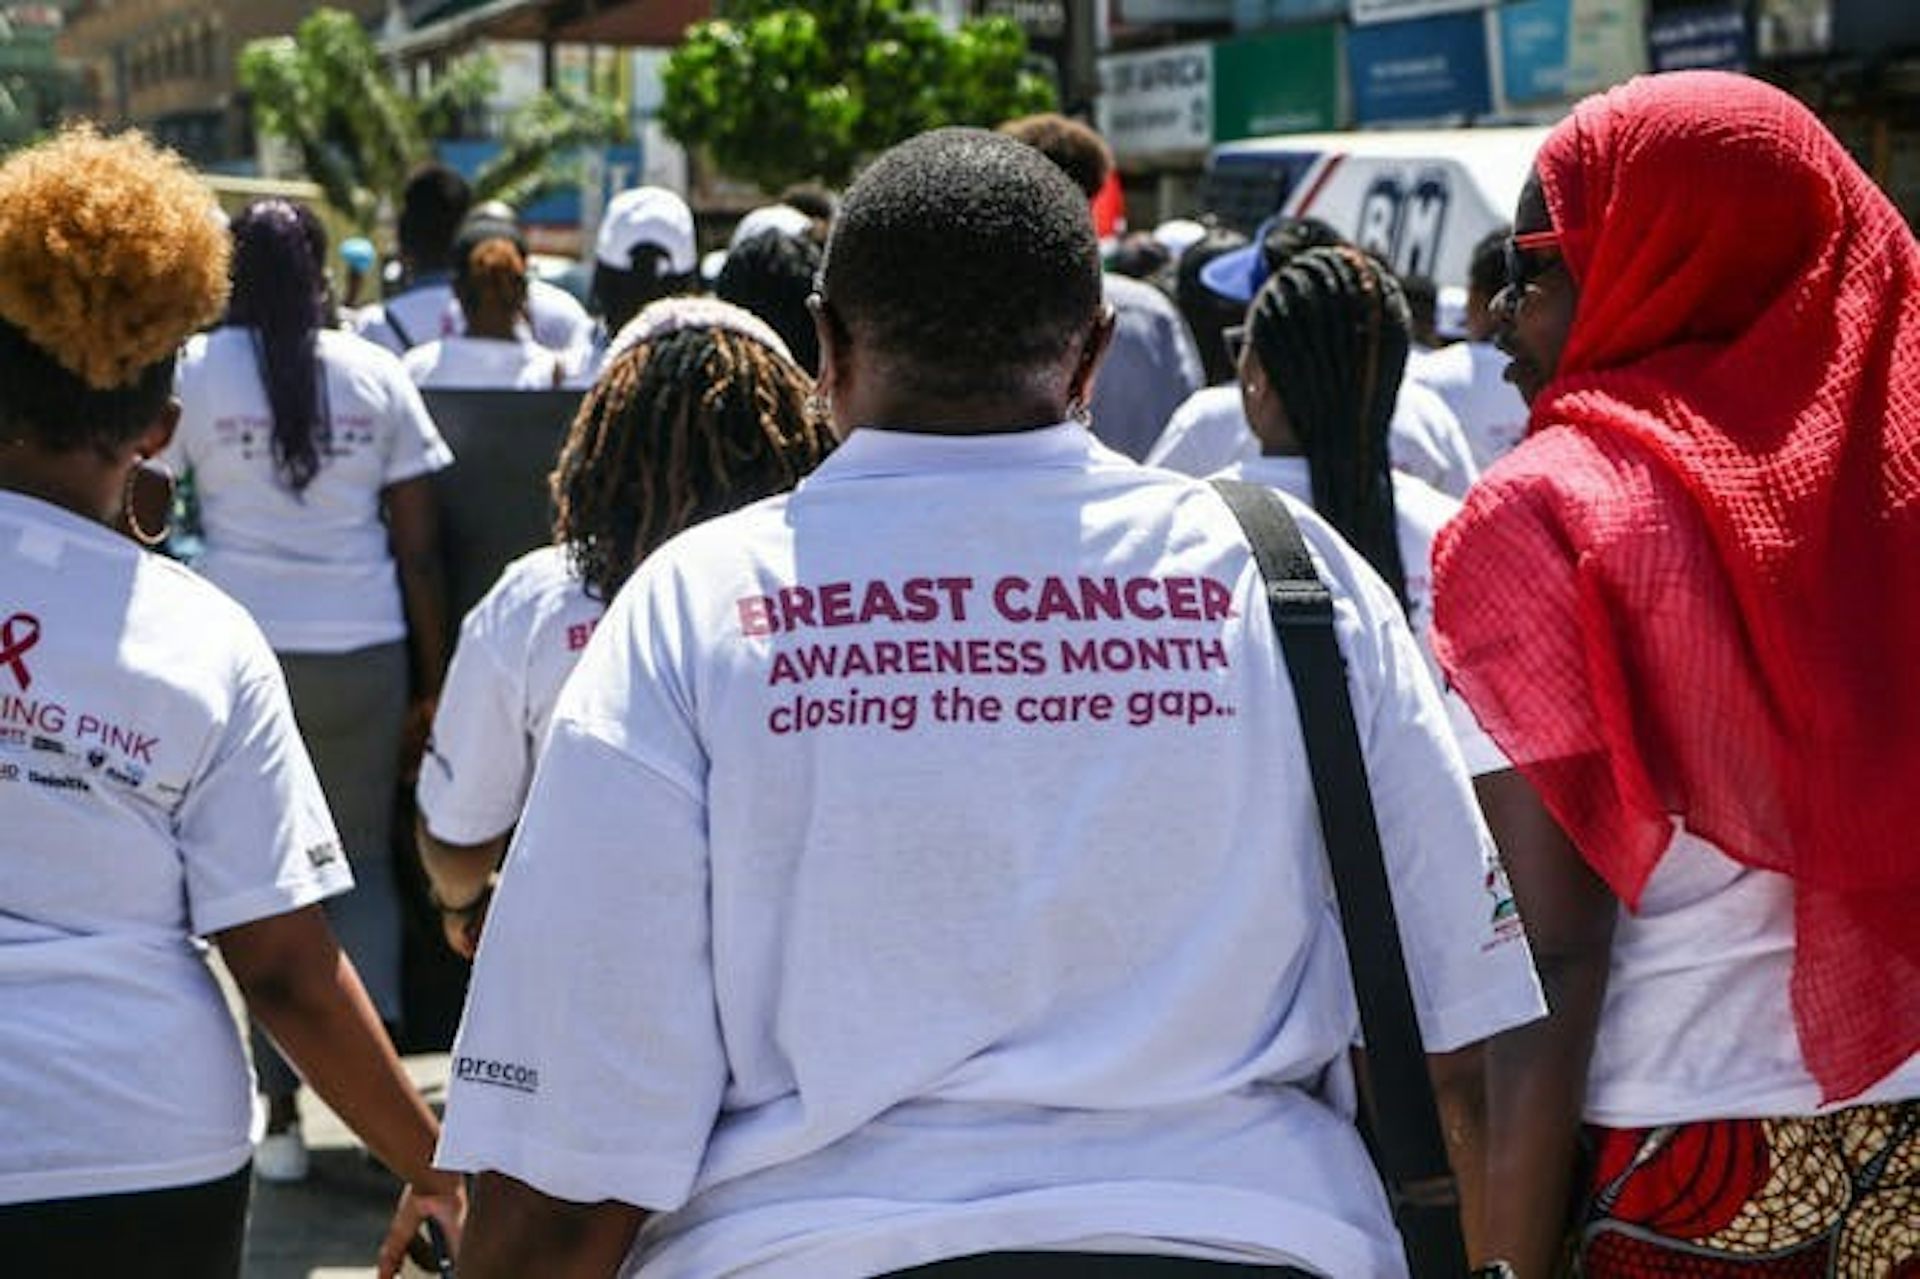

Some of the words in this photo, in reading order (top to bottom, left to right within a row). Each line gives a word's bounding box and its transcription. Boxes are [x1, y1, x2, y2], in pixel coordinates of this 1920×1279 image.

[737, 577, 973, 636] BREAST
[992, 575, 1240, 623] CANCER
[768, 640, 1046, 686] AWARENESS
[1060, 638, 1229, 674] MONTH
[768, 686, 918, 735] closing
[931, 686, 1003, 724] the
[1016, 693, 1114, 724] care
[77, 713, 160, 764] PINK
